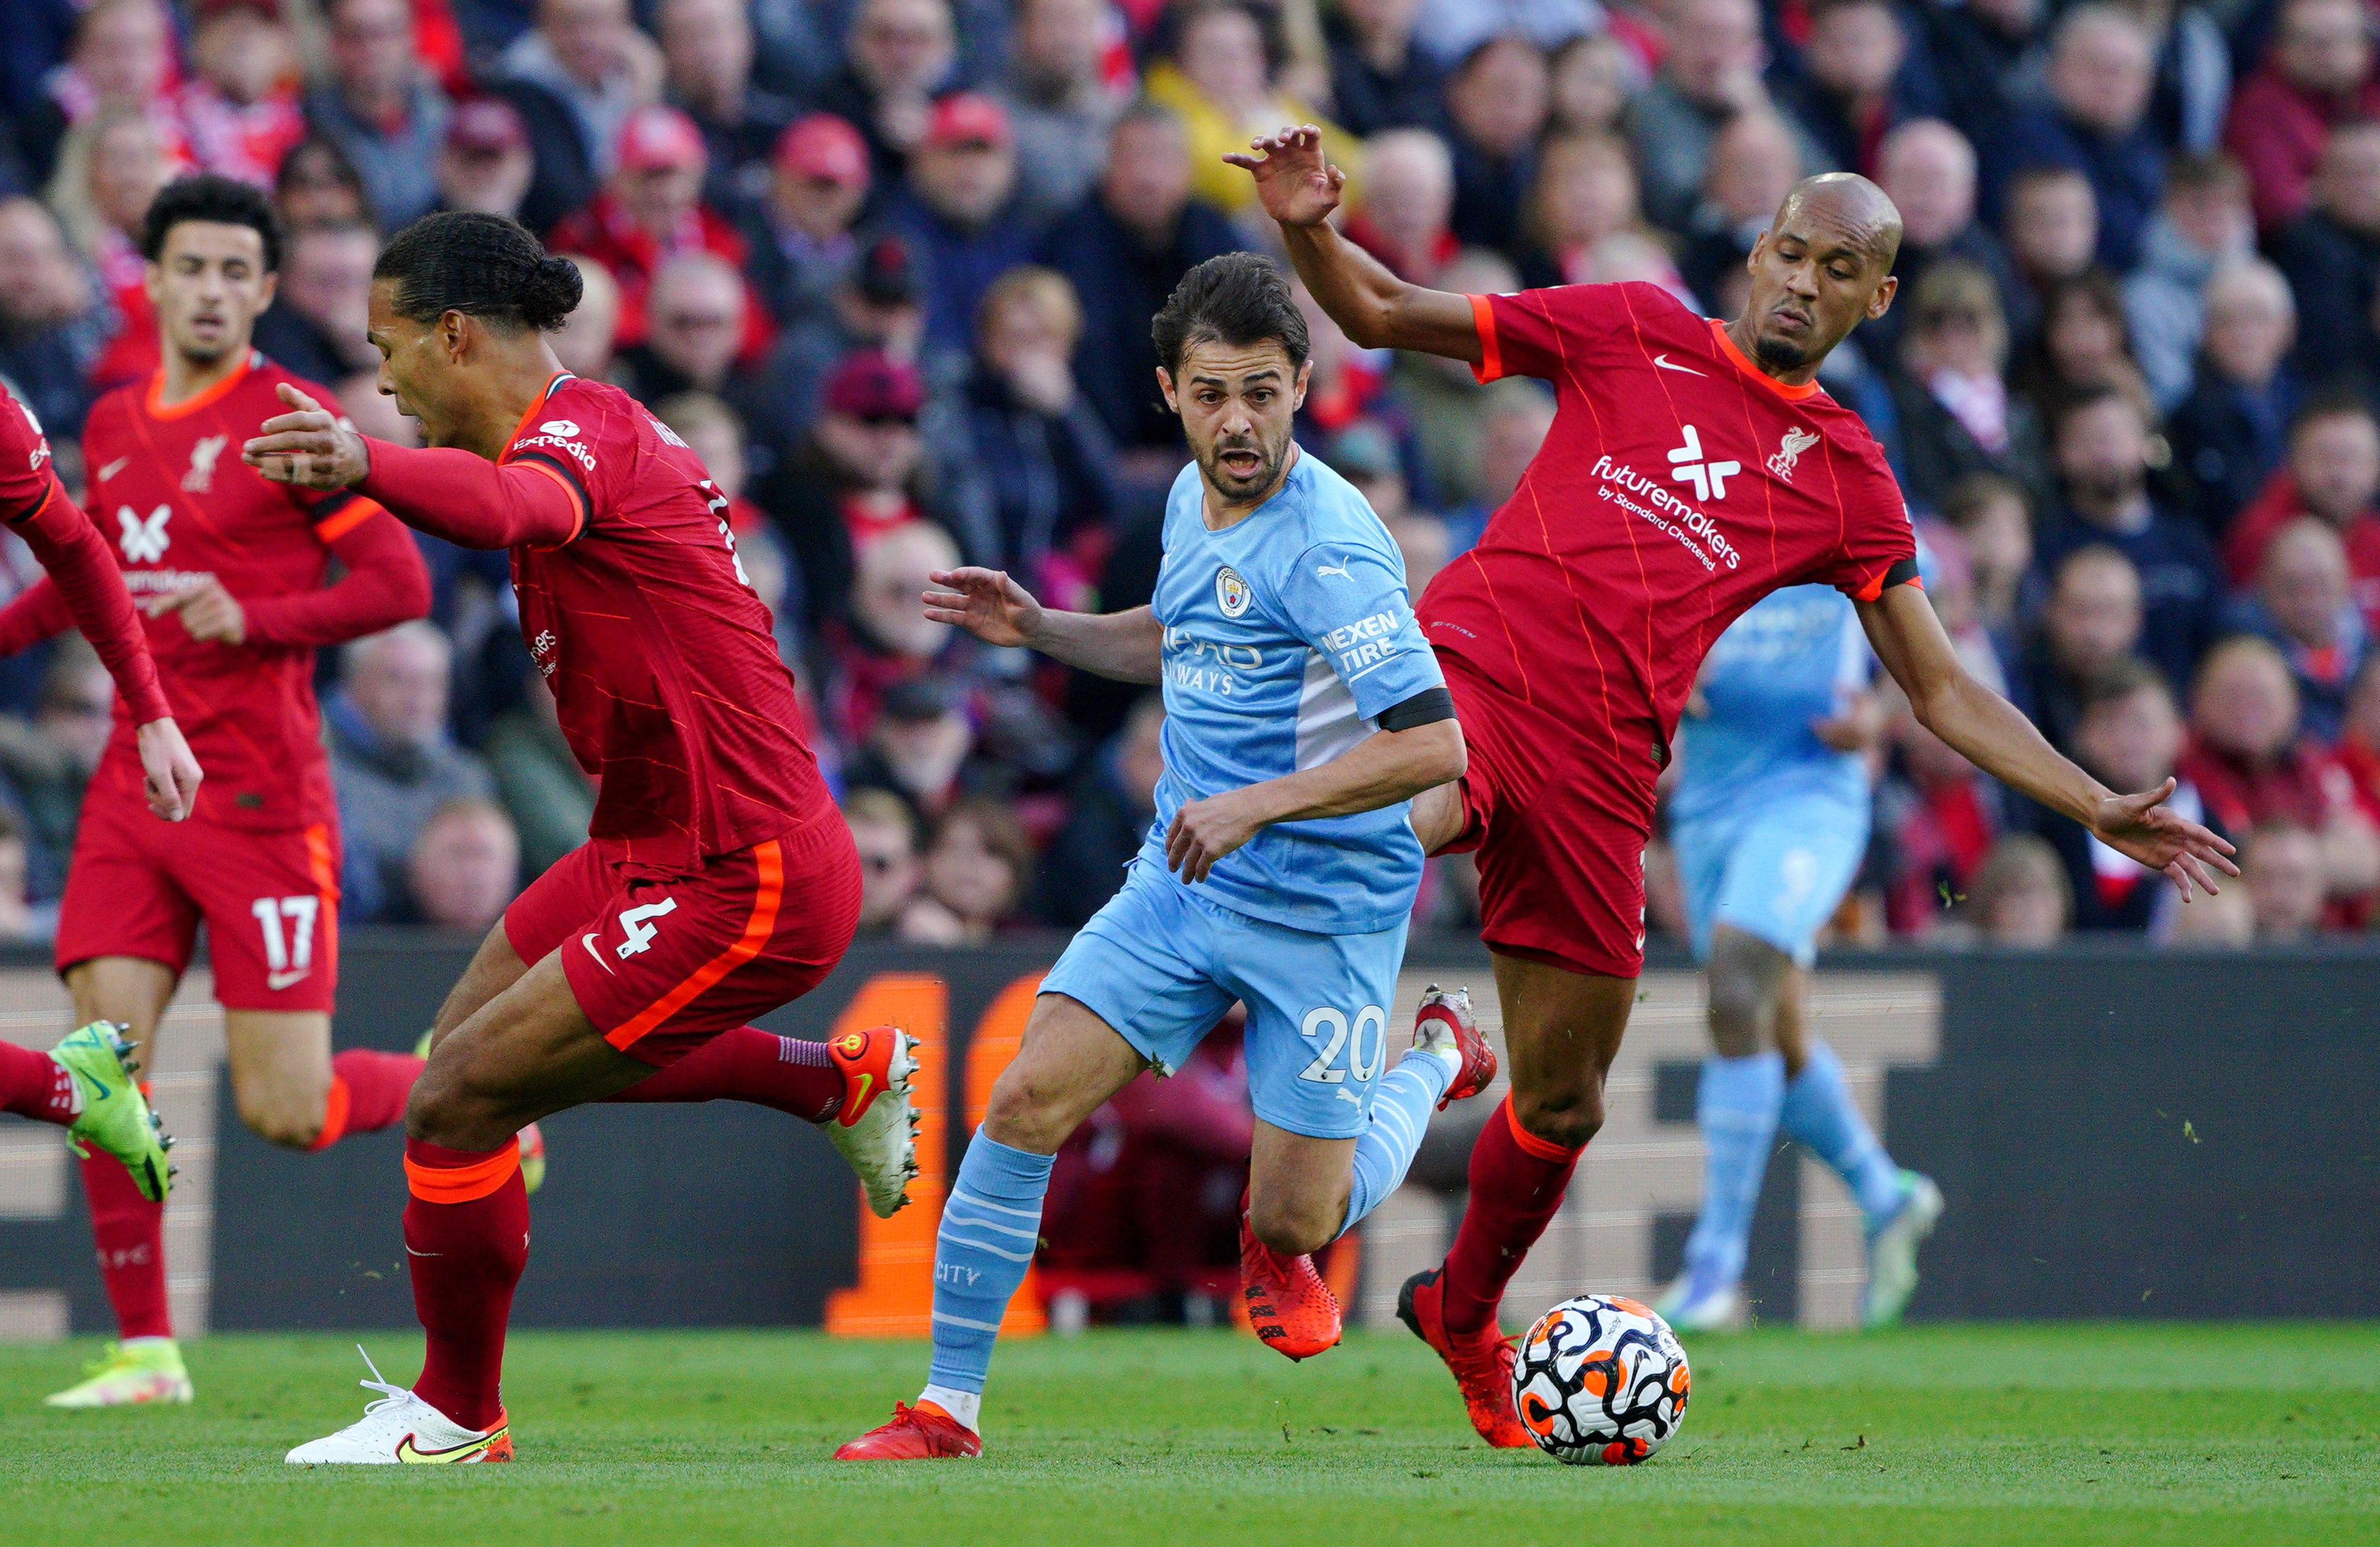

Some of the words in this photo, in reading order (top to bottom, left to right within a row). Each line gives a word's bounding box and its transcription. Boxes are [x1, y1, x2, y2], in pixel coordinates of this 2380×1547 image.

[512, 435, 596, 471] Expedia
[1591, 455, 1741, 569] futuremakers
[1598, 485, 1614, 501] by
[1614, 493, 1669, 530] Standard
[1668, 525, 1716, 571] Chartered
[1224, 608, 1236, 616] CITY
[1321, 610, 1399, 653] NEXEN
[1340, 637, 1397, 673] TIRE
[252, 895, 319, 970] 17
[616, 896, 678, 961] 4
[1298, 1004, 1385, 1084] 20
[936, 1260, 981, 1286] CITY
